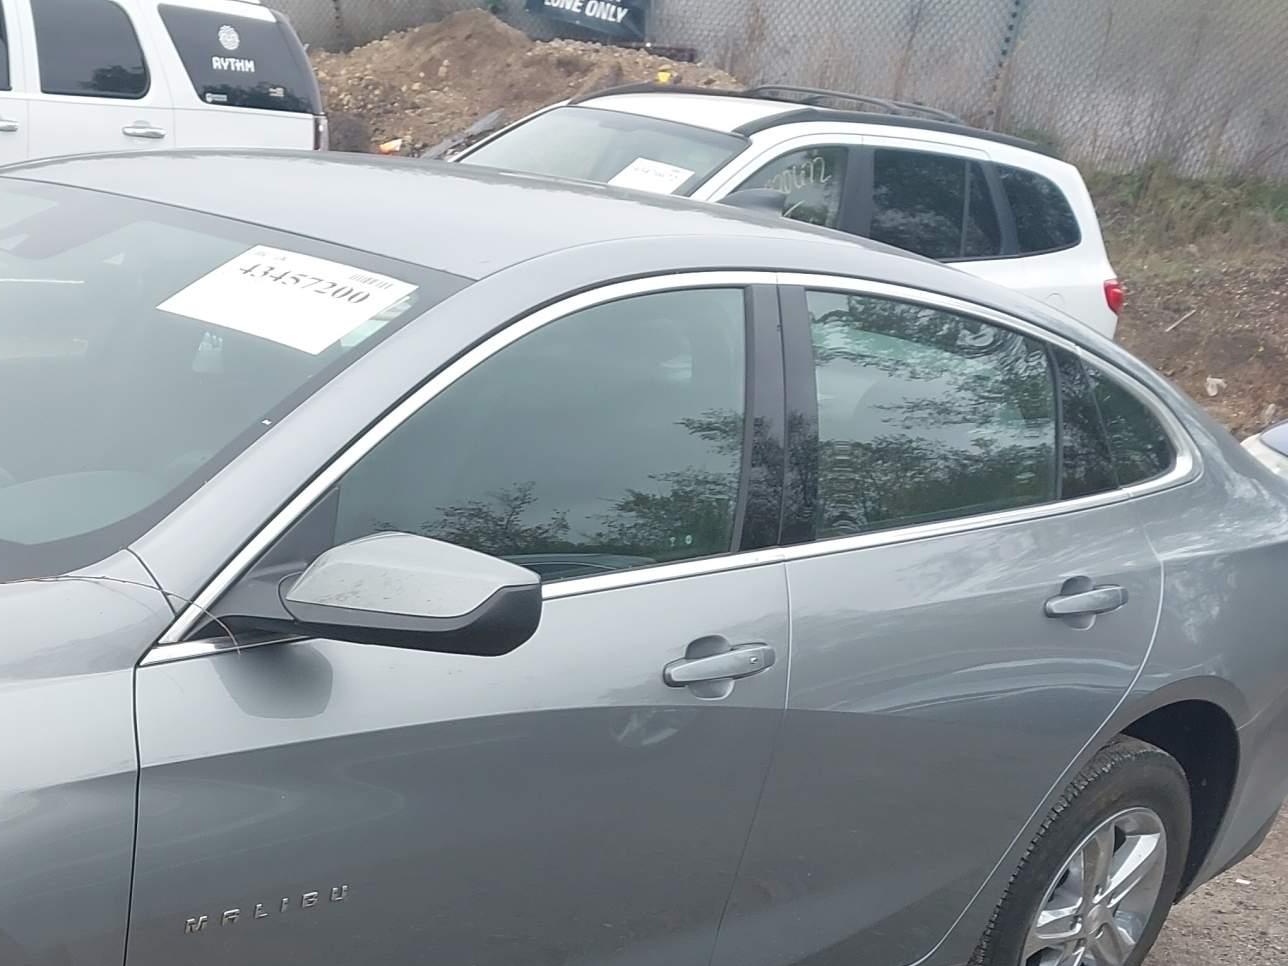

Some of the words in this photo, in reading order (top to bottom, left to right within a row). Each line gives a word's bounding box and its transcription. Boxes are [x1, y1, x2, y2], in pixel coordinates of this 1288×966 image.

[584, 0, 629, 23] ONLY
[212, 56, 255, 72] RYTHM
[239, 263, 371, 304] 43457200
[183, 885, 349, 934] MALIBU
